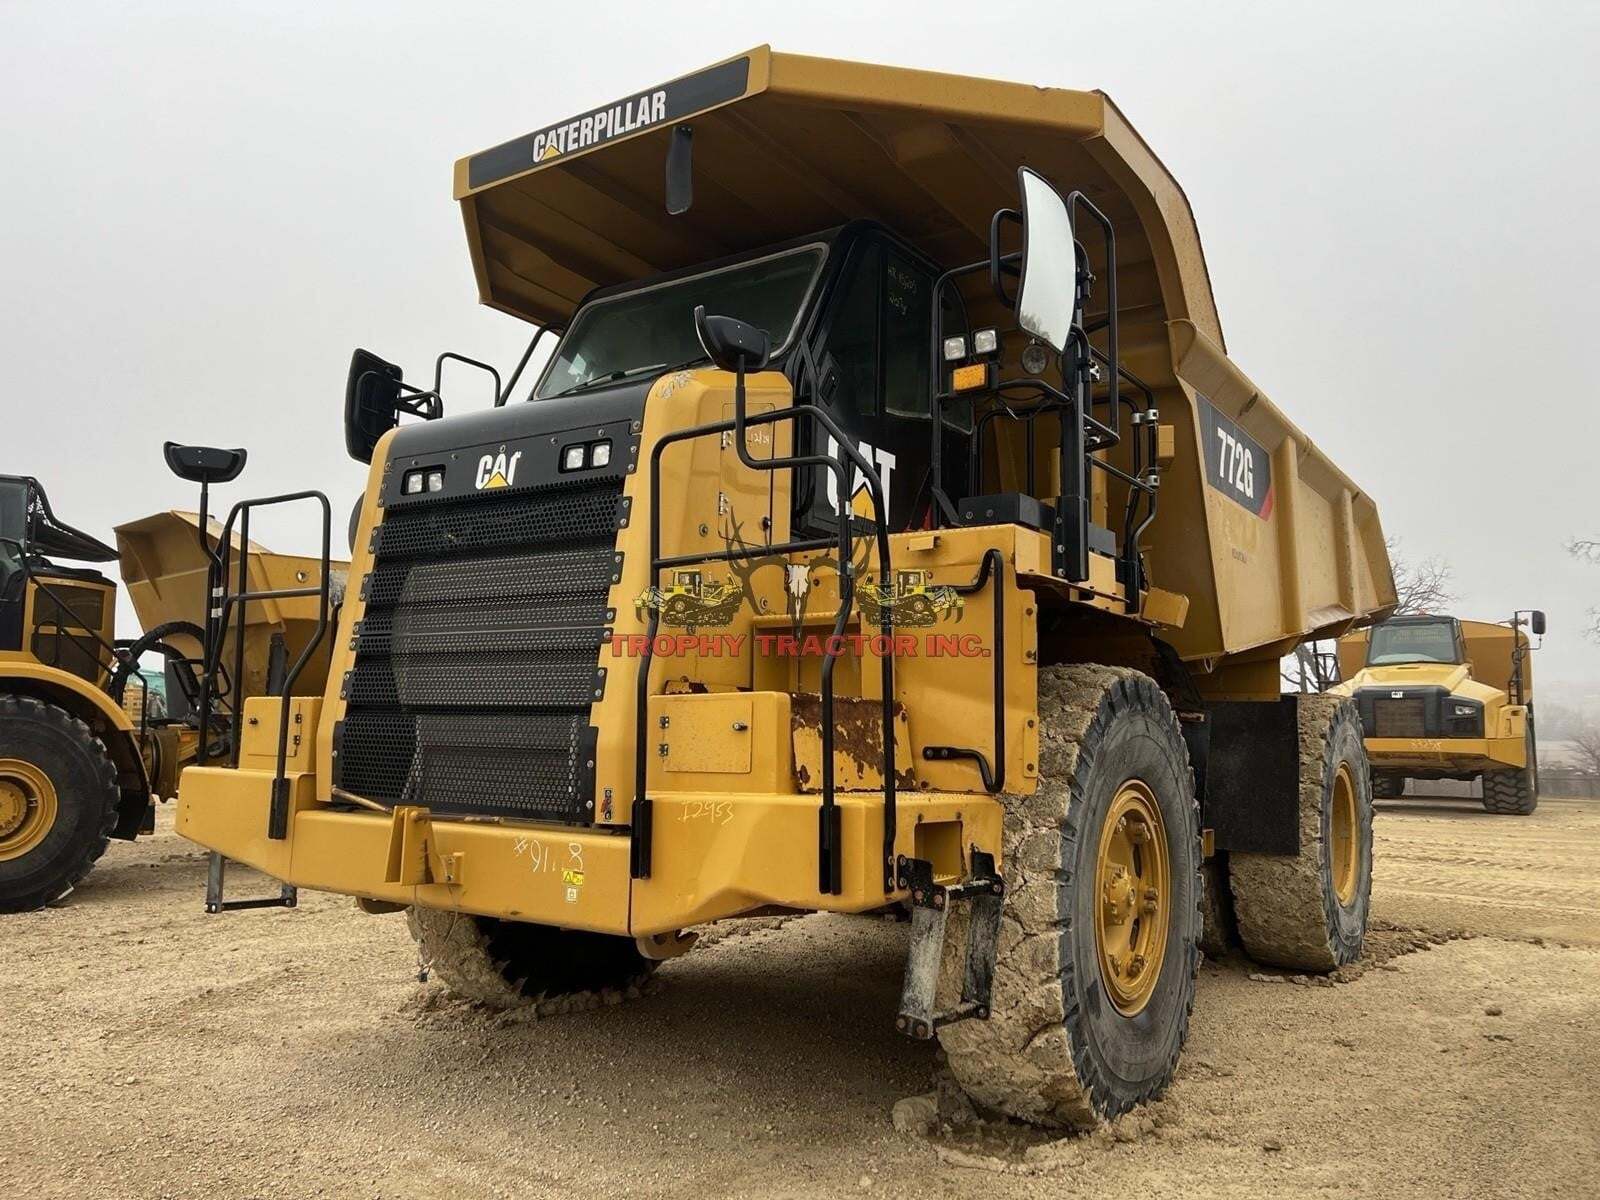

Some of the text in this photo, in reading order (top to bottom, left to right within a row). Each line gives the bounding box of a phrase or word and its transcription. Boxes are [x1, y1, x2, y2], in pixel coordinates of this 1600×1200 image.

[532, 90, 667, 163] CATERPILLAR
[475, 450, 522, 490] CAT
[1217, 426, 1254, 499] 772G
